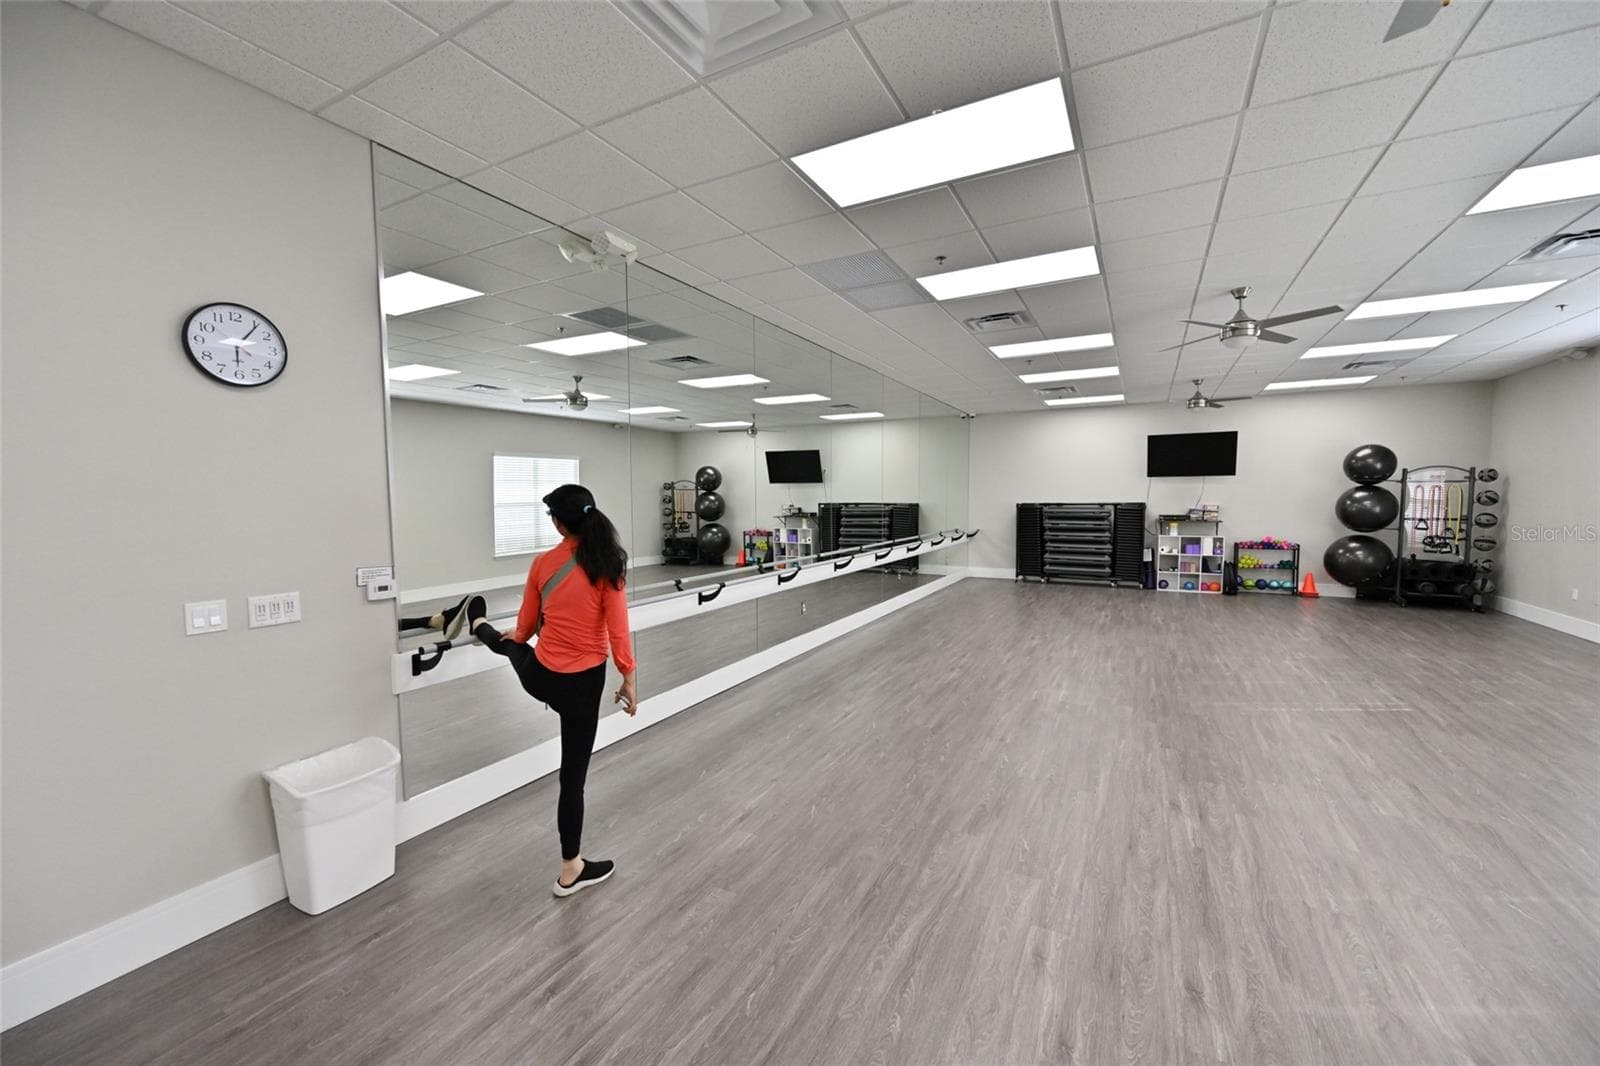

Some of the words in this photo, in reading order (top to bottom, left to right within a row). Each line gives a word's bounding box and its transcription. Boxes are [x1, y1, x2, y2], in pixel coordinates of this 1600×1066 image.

[213, 311, 223, 323] 11
[229, 311, 242, 323] 12
[200, 321, 215, 333] 10
[193, 334, 205, 345] 9
[262, 330, 271, 341] 2
[201, 350, 213, 361] 8
[268, 346, 278, 357] 3
[216, 362, 226, 373] 7
[264, 360, 273, 370] 4
[234, 368, 245, 380] 6
[251, 367, 261, 379] 5
